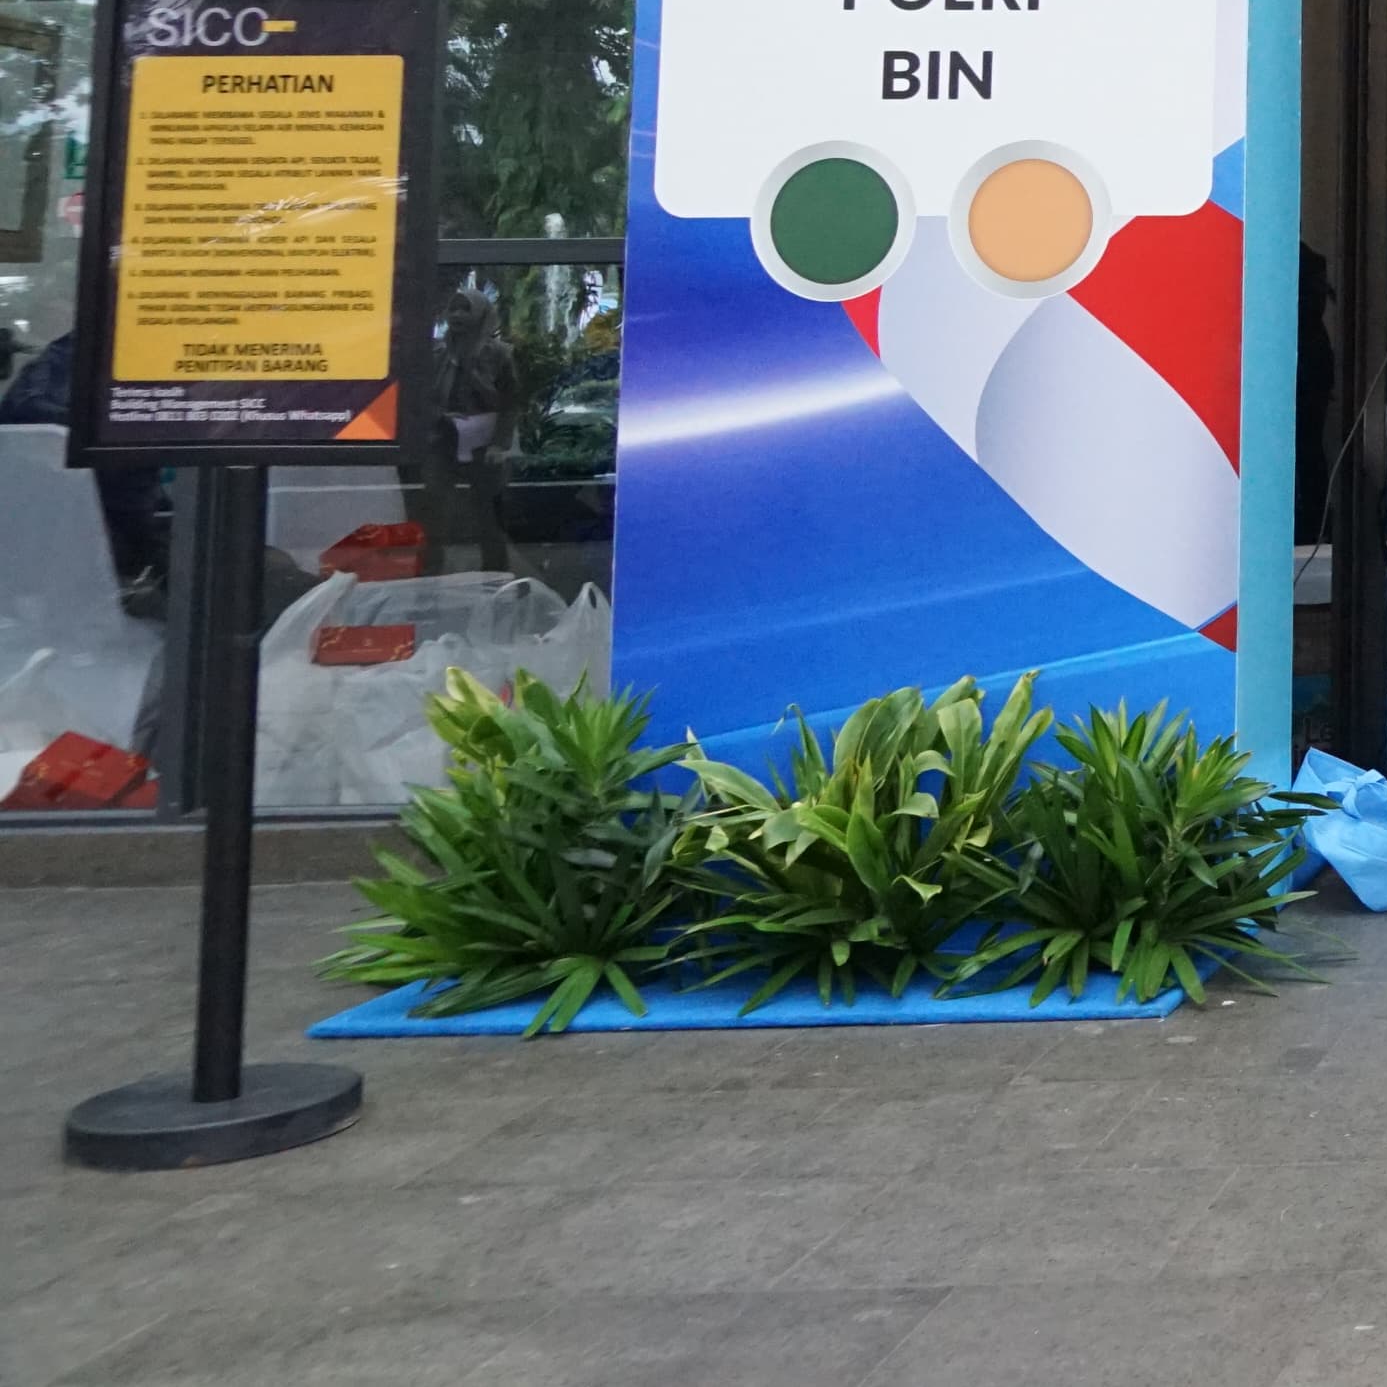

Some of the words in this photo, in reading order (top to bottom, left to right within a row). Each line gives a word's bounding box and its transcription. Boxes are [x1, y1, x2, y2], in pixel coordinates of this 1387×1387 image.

[202, 74, 335, 94] PERHATIAN
[881, 50, 993, 100] BIN
[183, 343, 230, 357] TIDAK
